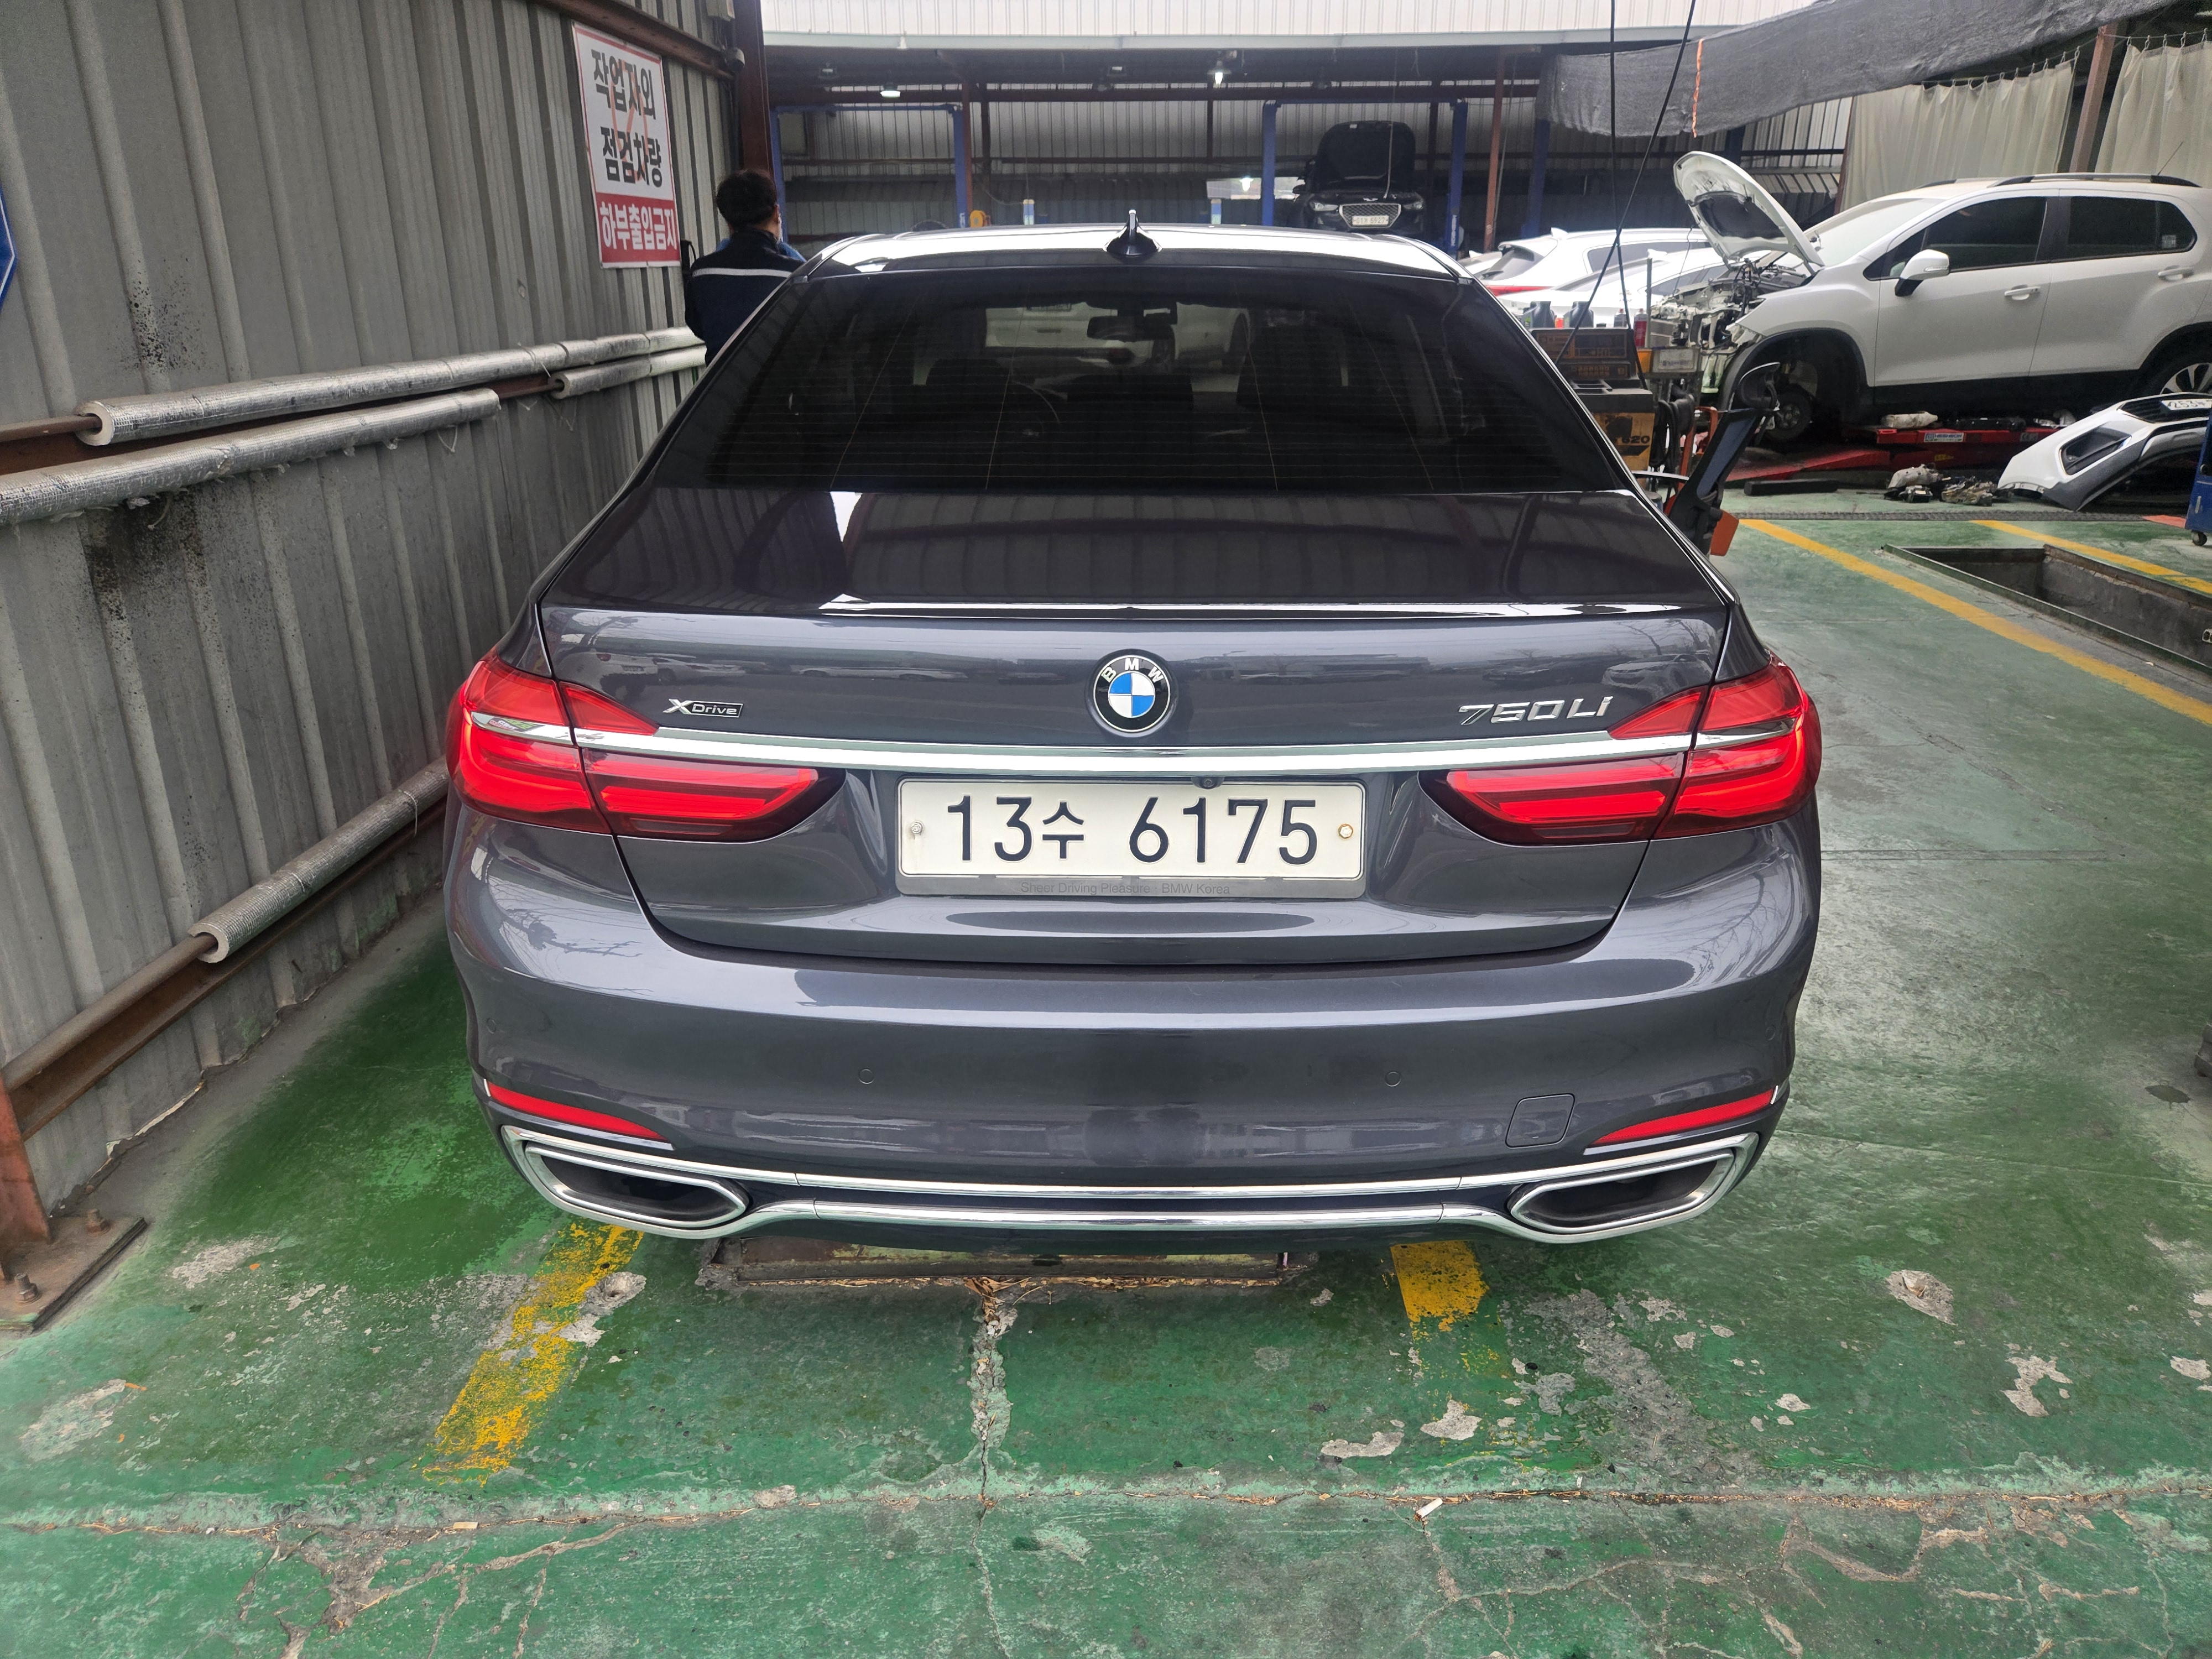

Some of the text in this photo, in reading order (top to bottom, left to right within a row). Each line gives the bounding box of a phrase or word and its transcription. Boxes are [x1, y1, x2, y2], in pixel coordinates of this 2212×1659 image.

[591, 49, 656, 120] 작업자외
[600, 126, 662, 188] 점검차량
[599, 201, 677, 251] 하부출입금지
[1101, 658, 1164, 683] BMW
[947, 795, 1318, 864] 13수 6175
[1021, 881, 1230, 895] Sheer Driving Pleasure BMW Korea
